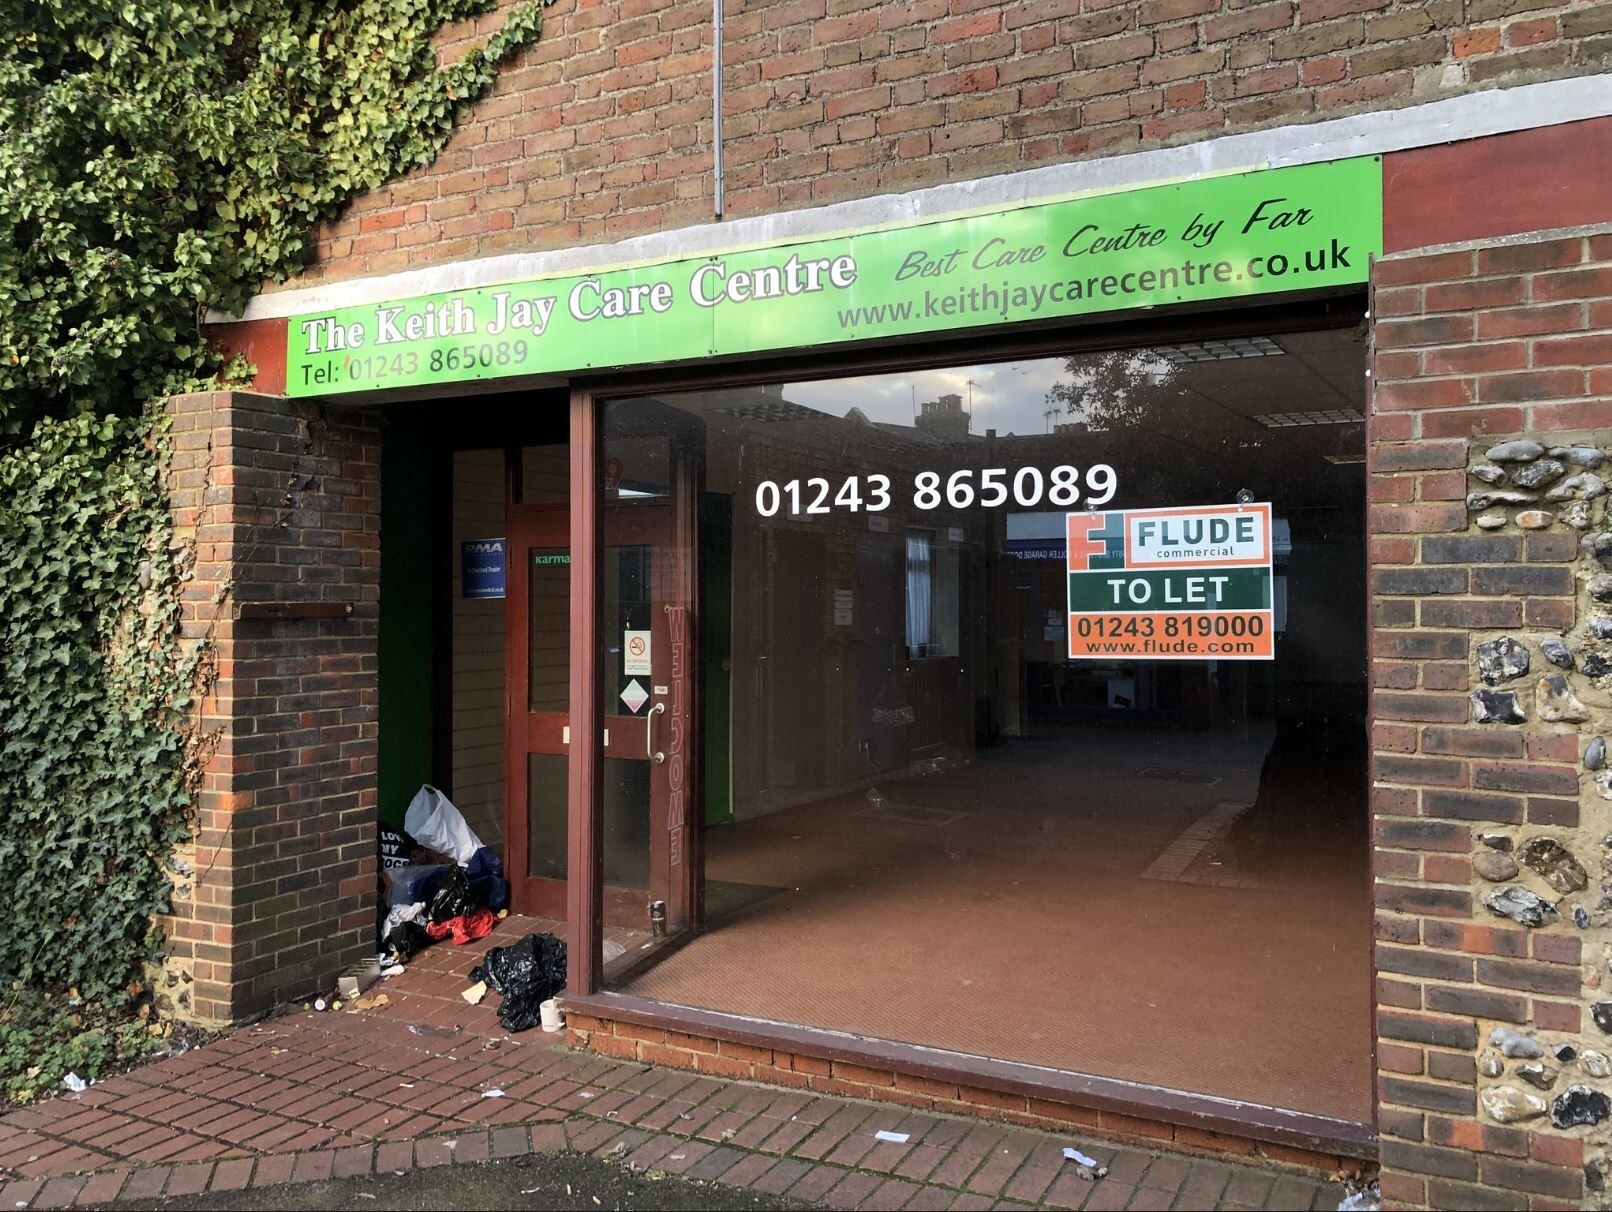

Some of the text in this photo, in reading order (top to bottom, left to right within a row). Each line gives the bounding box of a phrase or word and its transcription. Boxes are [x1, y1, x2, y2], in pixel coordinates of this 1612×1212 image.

[894, 198, 1315, 282] Best Care Centre by Far
[838, 239, 1352, 329] www.keithjaycarecentre.co.uk
[302, 254, 857, 354] The Keith Jay Care Centre
[301, 338, 529, 386] Tel: 01243 865089
[755, 463, 1118, 518] 01243 865089
[1138, 516, 1255, 547] FLUDE
[1157, 546, 1235, 560] commercial
[1108, 576, 1229, 604] TO LET
[1077, 615, 1264, 639] 01243 819000
[1086, 639, 1256, 654] www.flude.com
